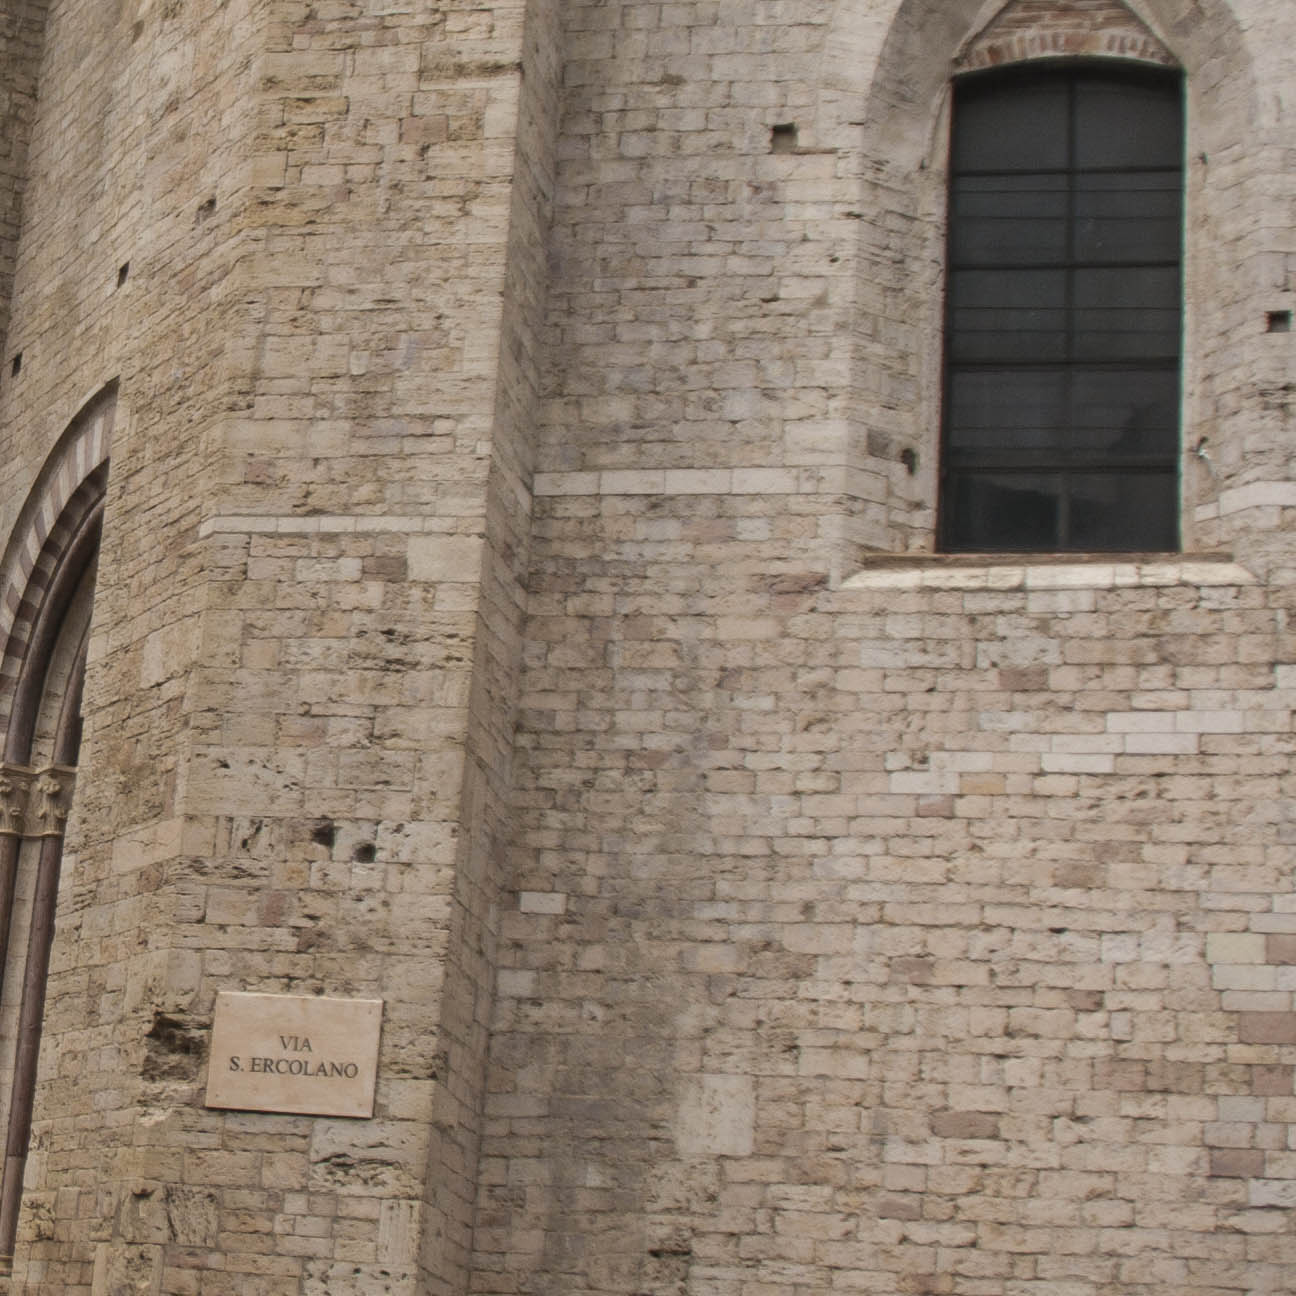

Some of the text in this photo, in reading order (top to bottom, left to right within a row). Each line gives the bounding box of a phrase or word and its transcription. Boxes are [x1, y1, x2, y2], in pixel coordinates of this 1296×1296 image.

[279, 1035, 313, 1052] VIA
[229, 1056, 358, 1078] S. ERCOLANO
